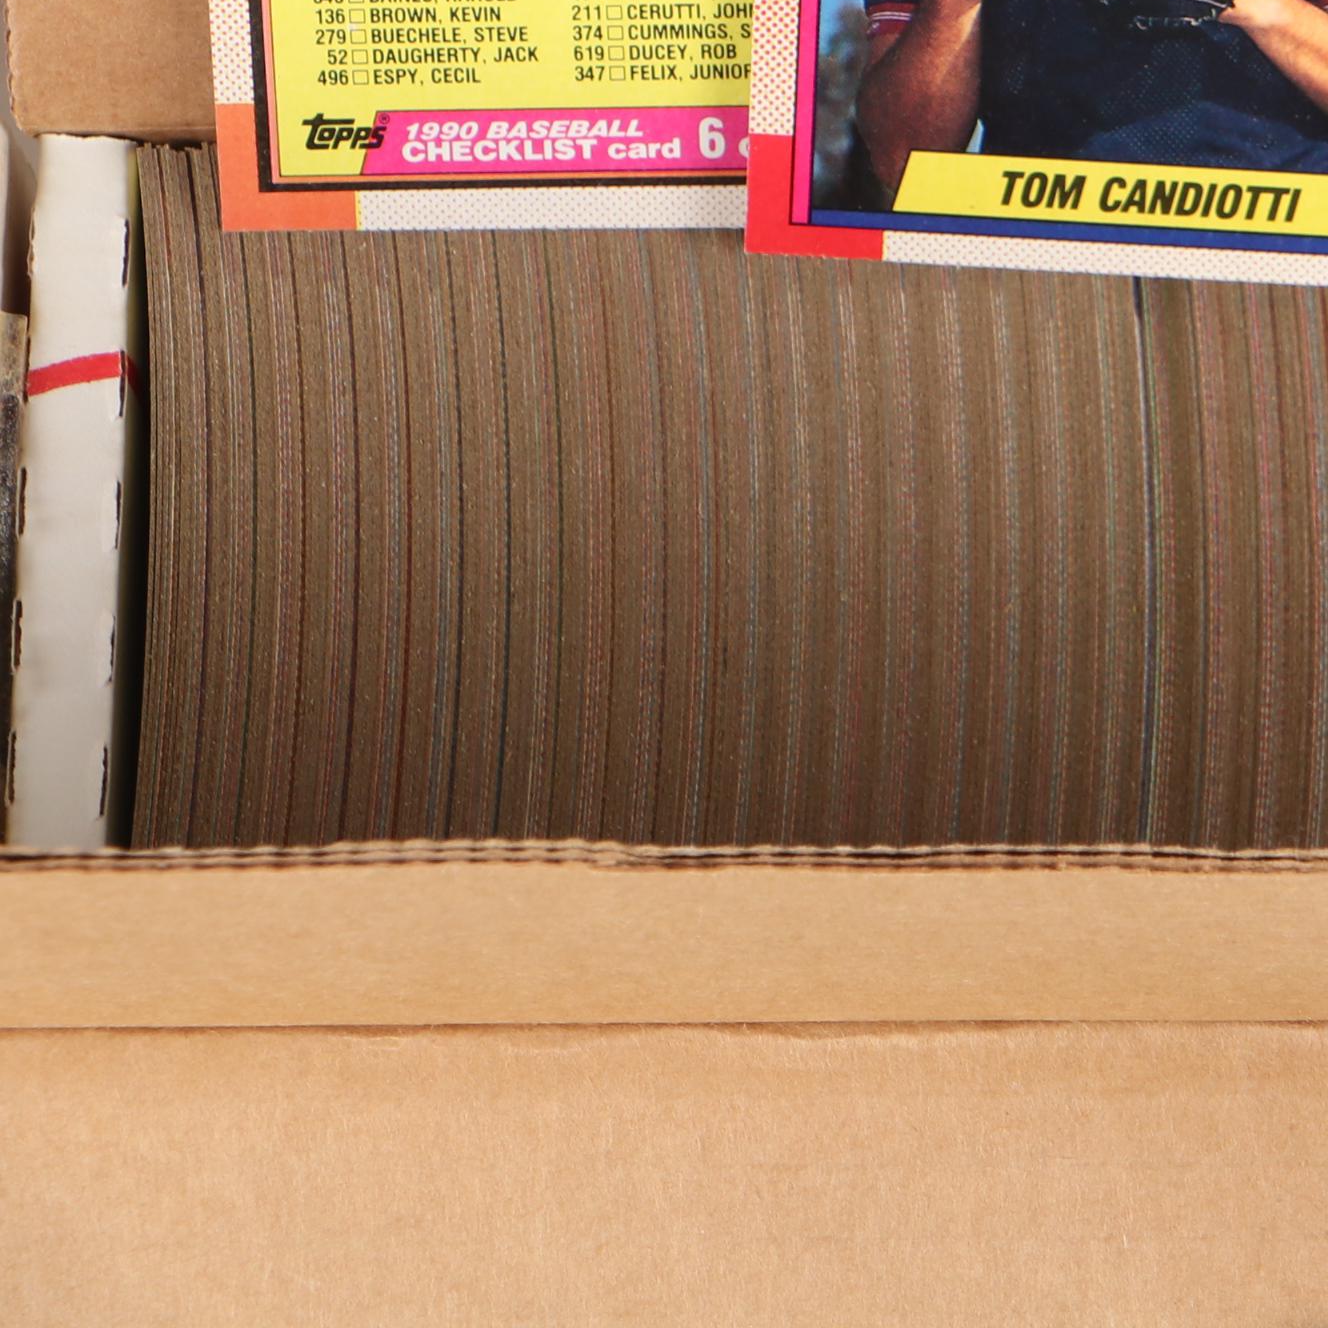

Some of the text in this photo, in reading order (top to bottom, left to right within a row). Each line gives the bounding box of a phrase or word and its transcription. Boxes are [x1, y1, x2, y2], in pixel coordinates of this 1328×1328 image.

[401, 138, 598, 164] CHECKLIST
[607, 137, 681, 160] card
[698, 117, 726, 159] 6
[405, 119, 643, 141] 1990 BASEBALL
[1001, 170, 1302, 223] TOM CANDIOTTI
